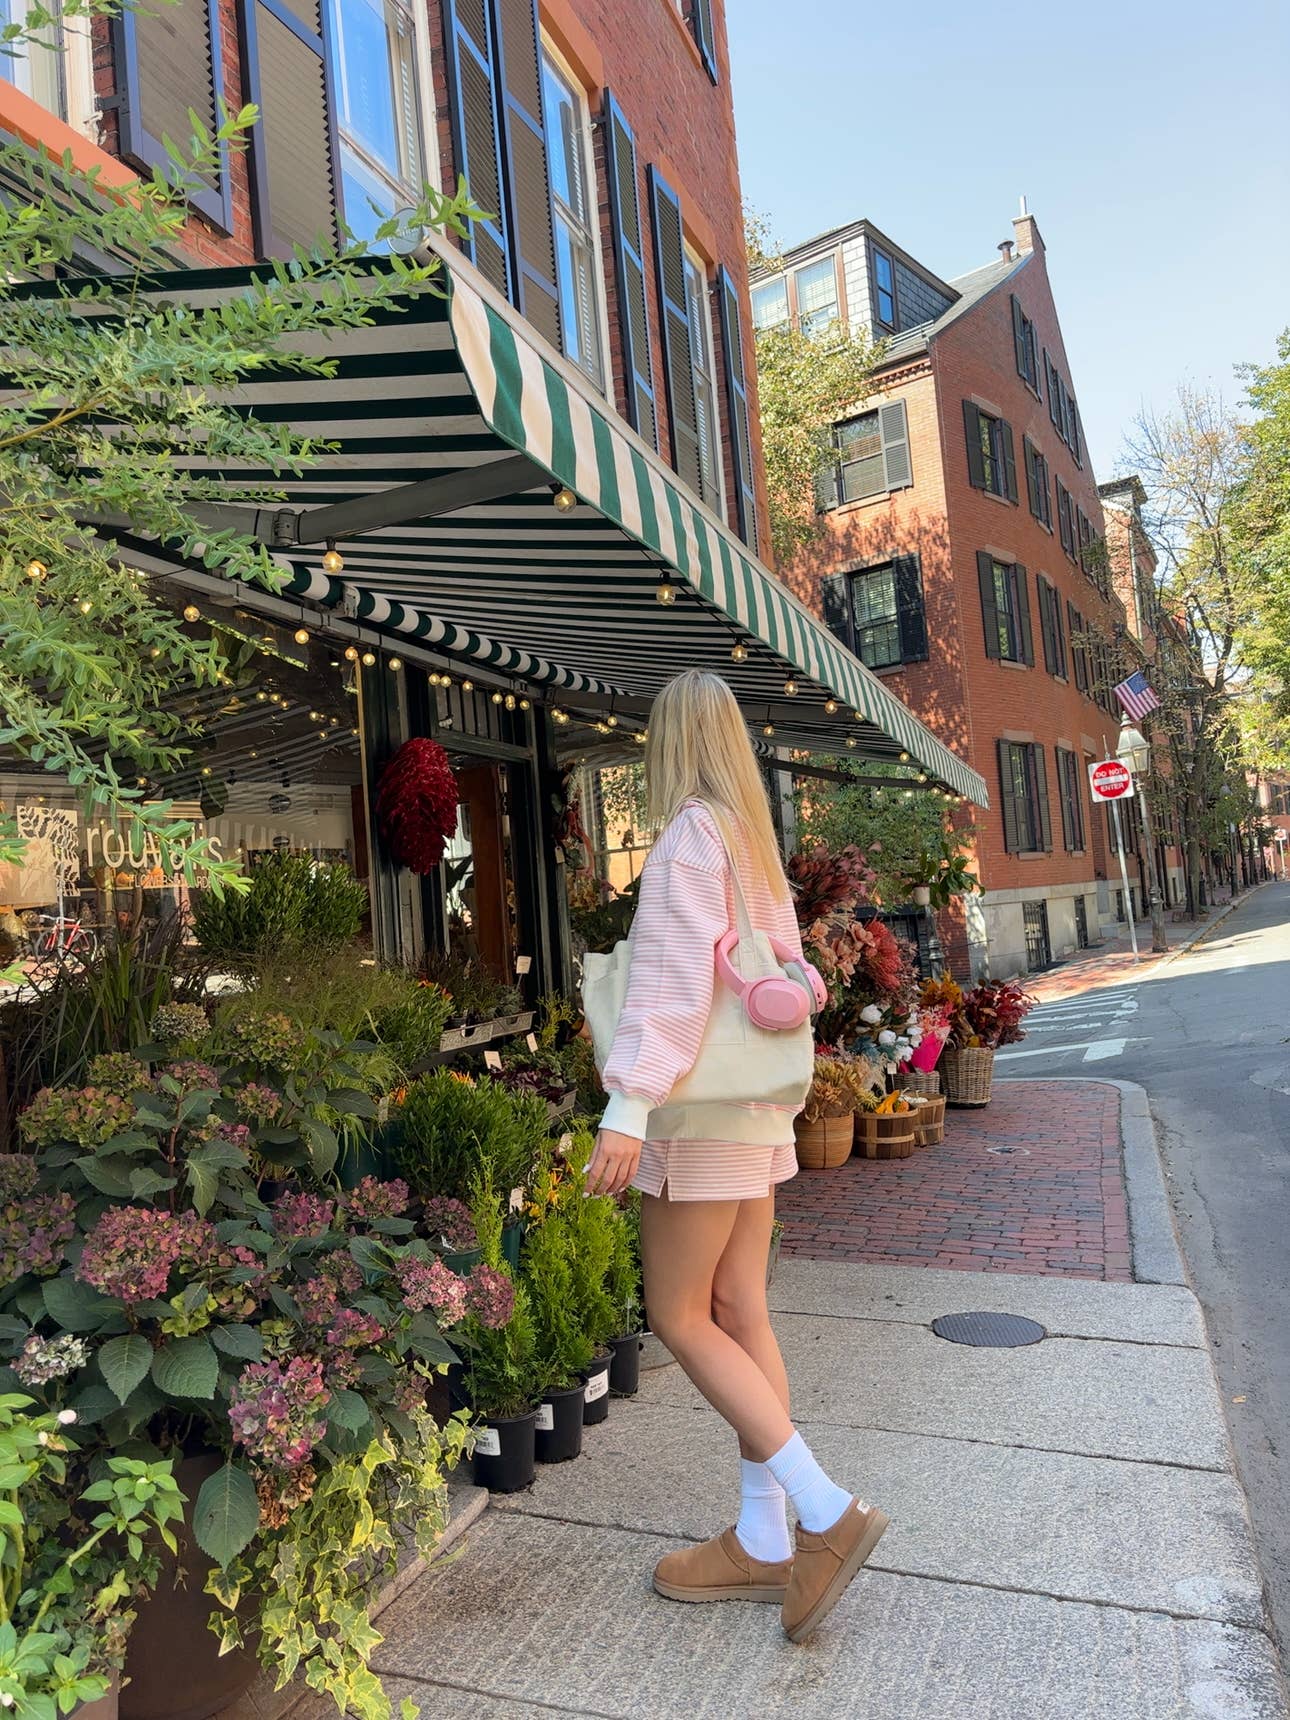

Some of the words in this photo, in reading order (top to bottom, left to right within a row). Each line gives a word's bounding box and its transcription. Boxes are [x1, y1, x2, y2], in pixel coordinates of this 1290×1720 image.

[1095, 770, 1107, 778] DO
[1108, 767, 1125, 776] NOT
[1100, 782, 1125, 793] ENTER
